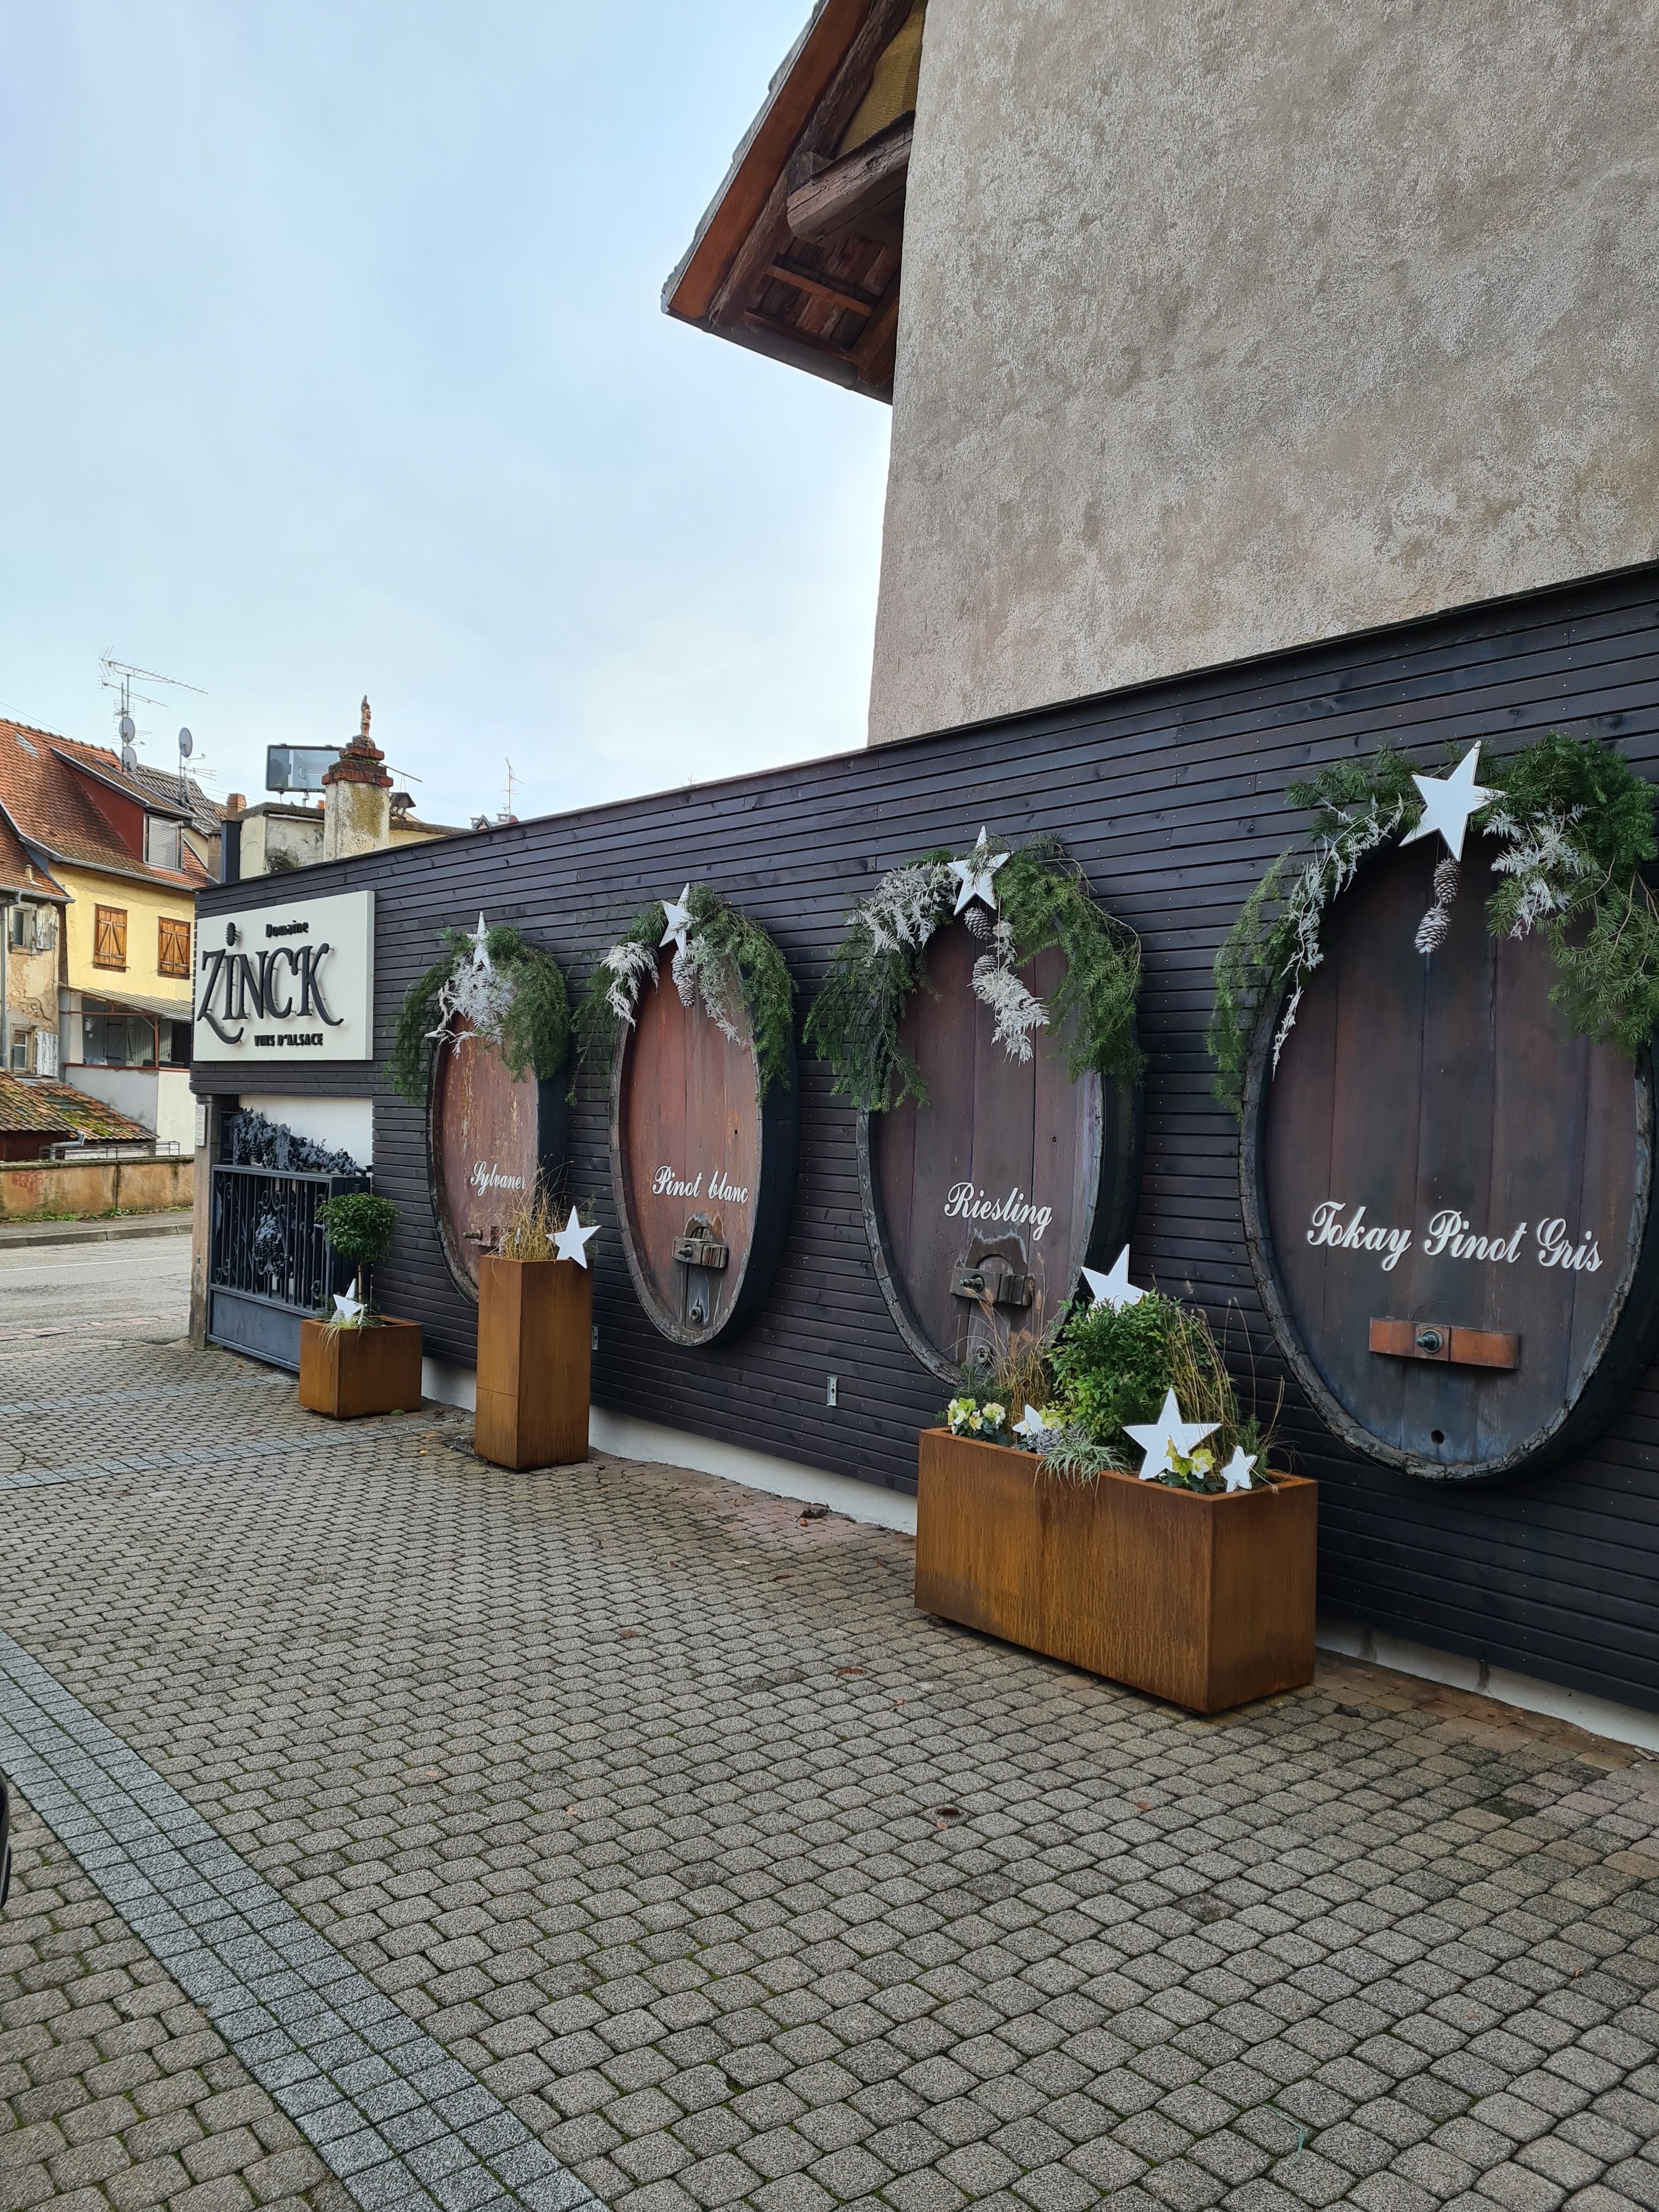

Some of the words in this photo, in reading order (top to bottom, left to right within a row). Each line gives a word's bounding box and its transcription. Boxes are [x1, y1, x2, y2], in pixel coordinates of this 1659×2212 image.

[266, 920, 308, 938] Domaine
[196, 943, 344, 1044] ZINCK
[254, 1035, 275, 1046] VINS
[277, 1034, 323, 1046] D'ALSACE
[470, 1161, 526, 1197] Sylvaner
[652, 1166, 702, 1198] Pinot
[708, 1170, 748, 1203] blanc
[944, 1182, 1053, 1241] Riesling
[1307, 1201, 1412, 1272] Tokay
[1424, 1210, 1527, 1263] Pinot
[1537, 1217, 1603, 1272] Gris
